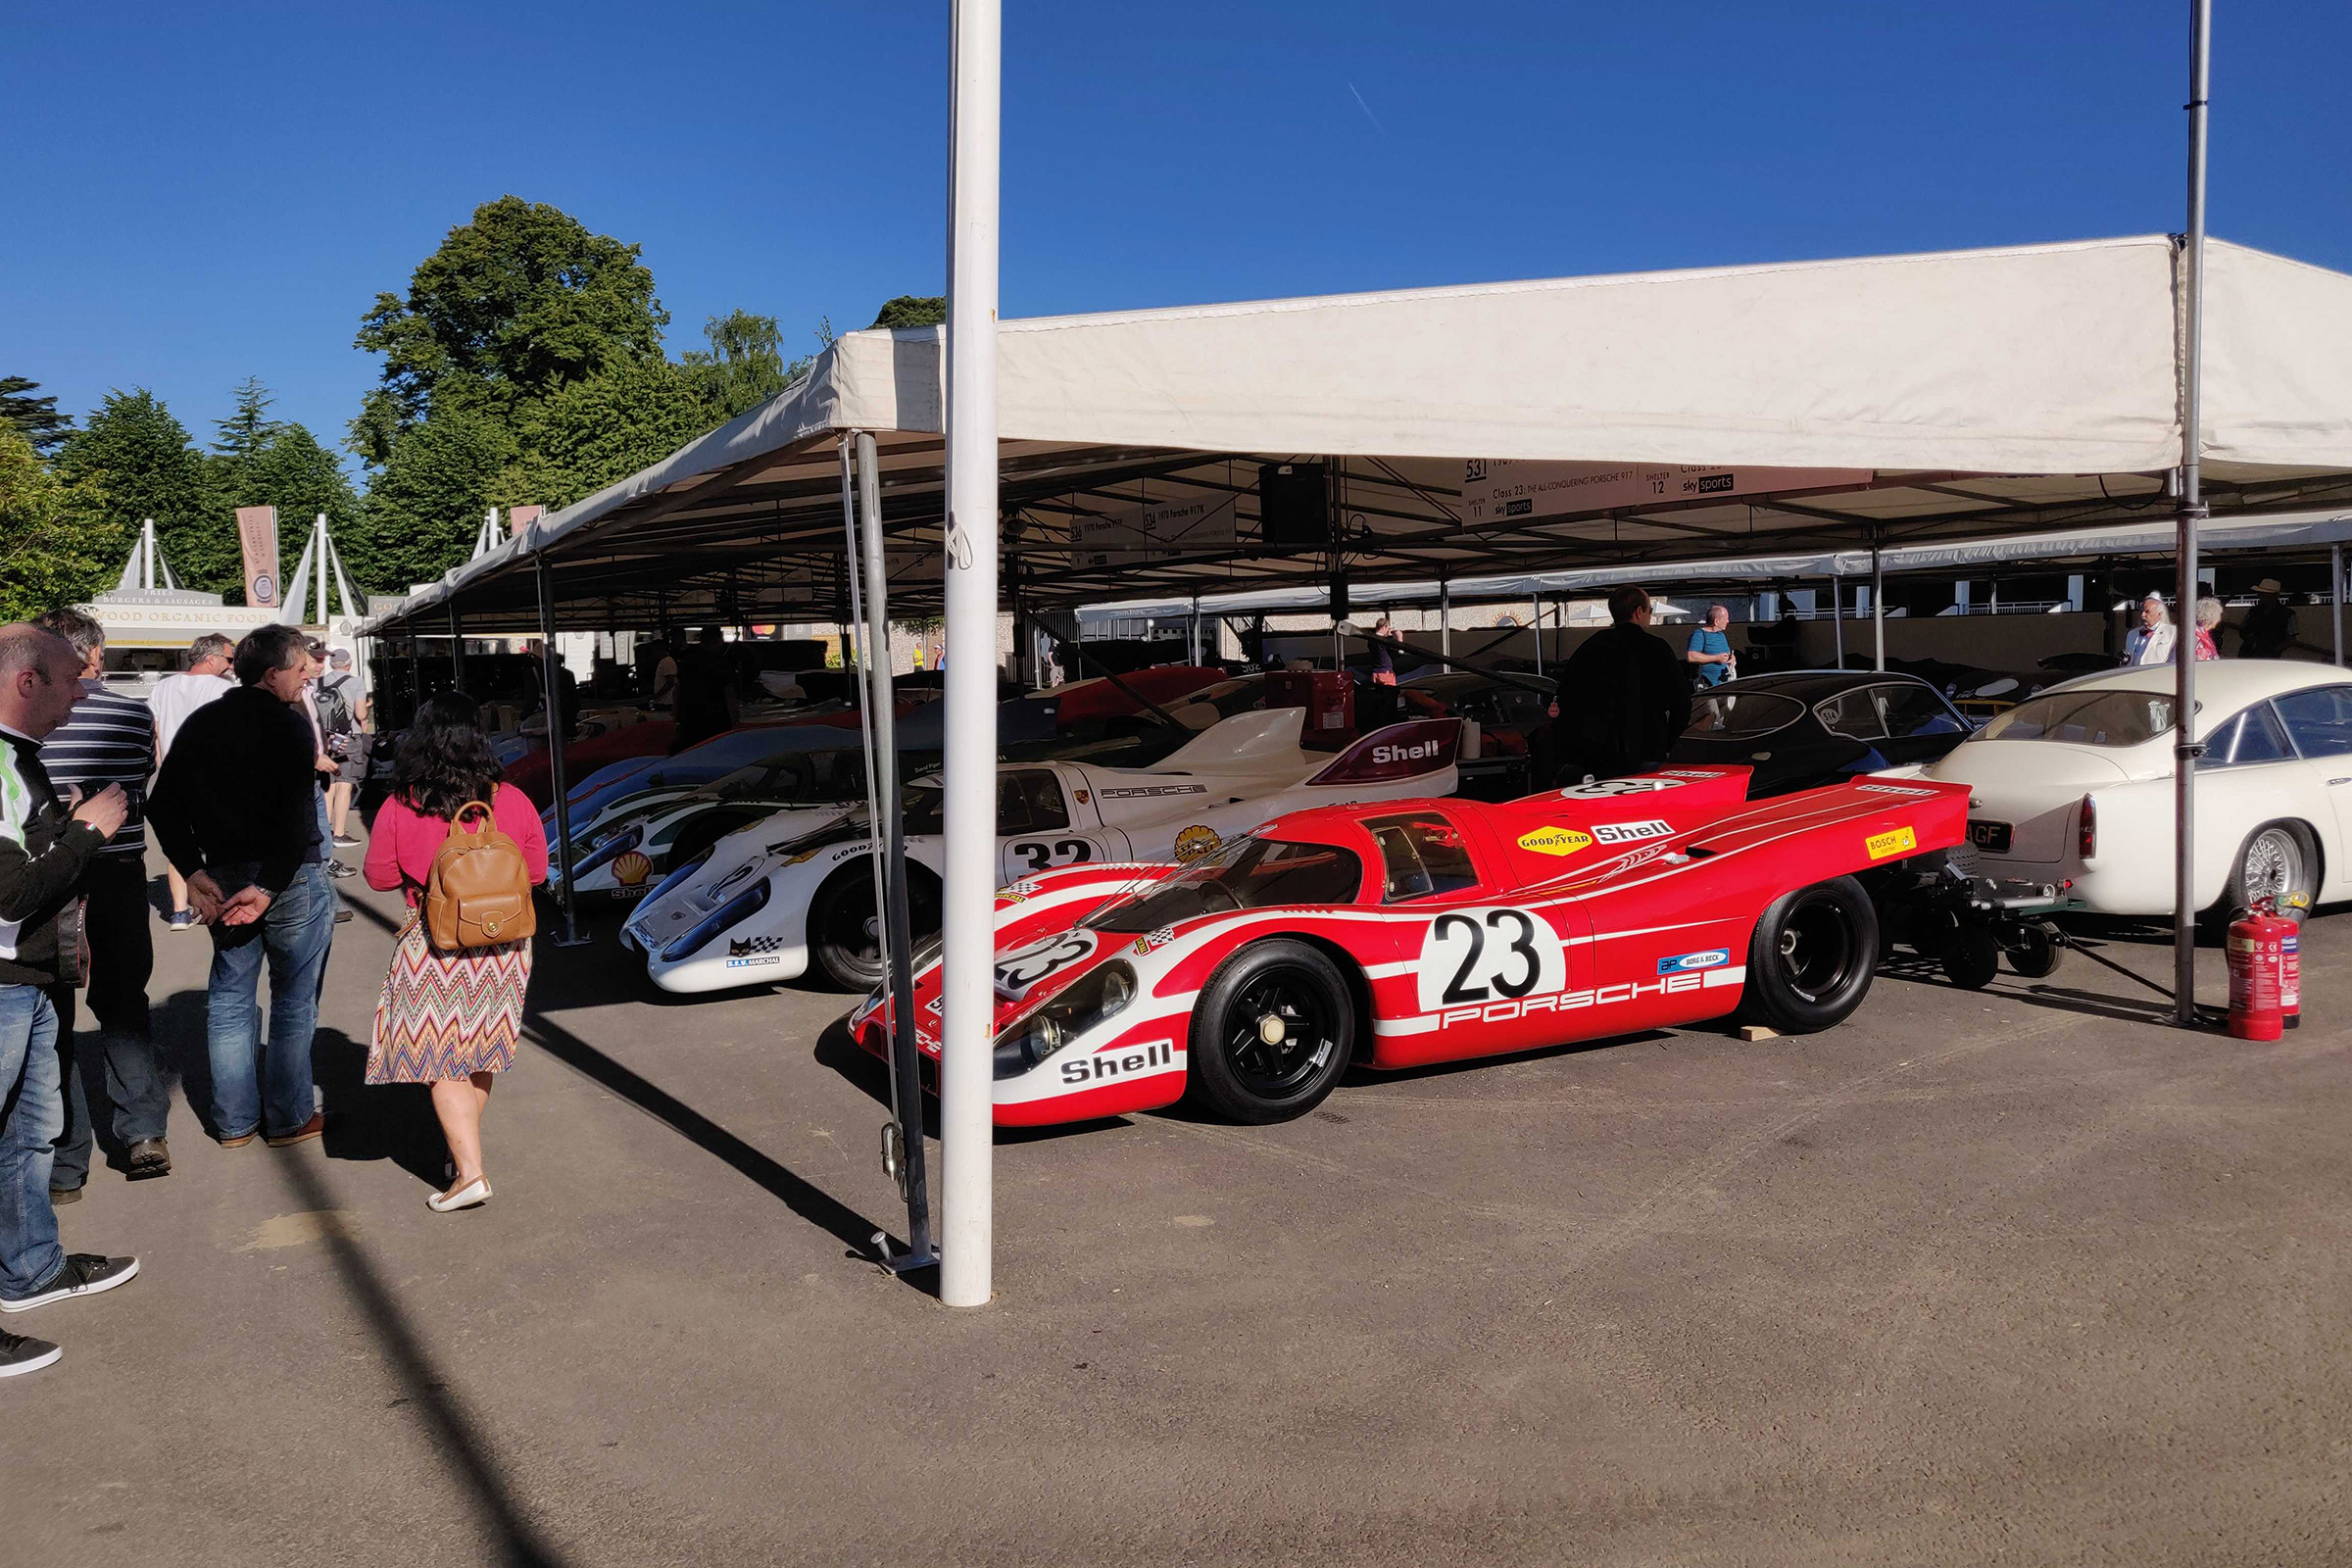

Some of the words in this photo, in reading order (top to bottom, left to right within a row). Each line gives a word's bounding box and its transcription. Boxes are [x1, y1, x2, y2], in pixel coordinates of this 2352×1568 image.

[1646, 471, 1669, 481] SHELTER
[1493, 488, 1512, 500] Class
[1591, 472, 1619, 484] PORSCHE
[1621, 470, 1633, 480] 917
[1652, 481, 1664, 494] 12
[1683, 480, 1697, 493] sky
[1700, 476, 1732, 491] sports
[1473, 506, 1482, 517] 11
[1494, 504, 1505, 516] sky
[1507, 501, 1532, 515] sports
[149, 612, 221, 623] ORGANIC
[227, 613, 269, 623] FOOD
[1372, 740, 1440, 764] Shell
[1100, 785, 1207, 799] PORSCHE
[1861, 784, 1936, 796] Shell
[1595, 822, 1672, 843] Shell
[1521, 835, 1590, 847] GOODYEAR
[1870, 836, 1897, 851] BOSCH
[749, 956, 780, 965] MARCHAL
[1434, 908, 1541, 1005] 23
[1442, 972, 1702, 1030] PORSCHE
[1060, 1043, 1172, 1085] Shell
